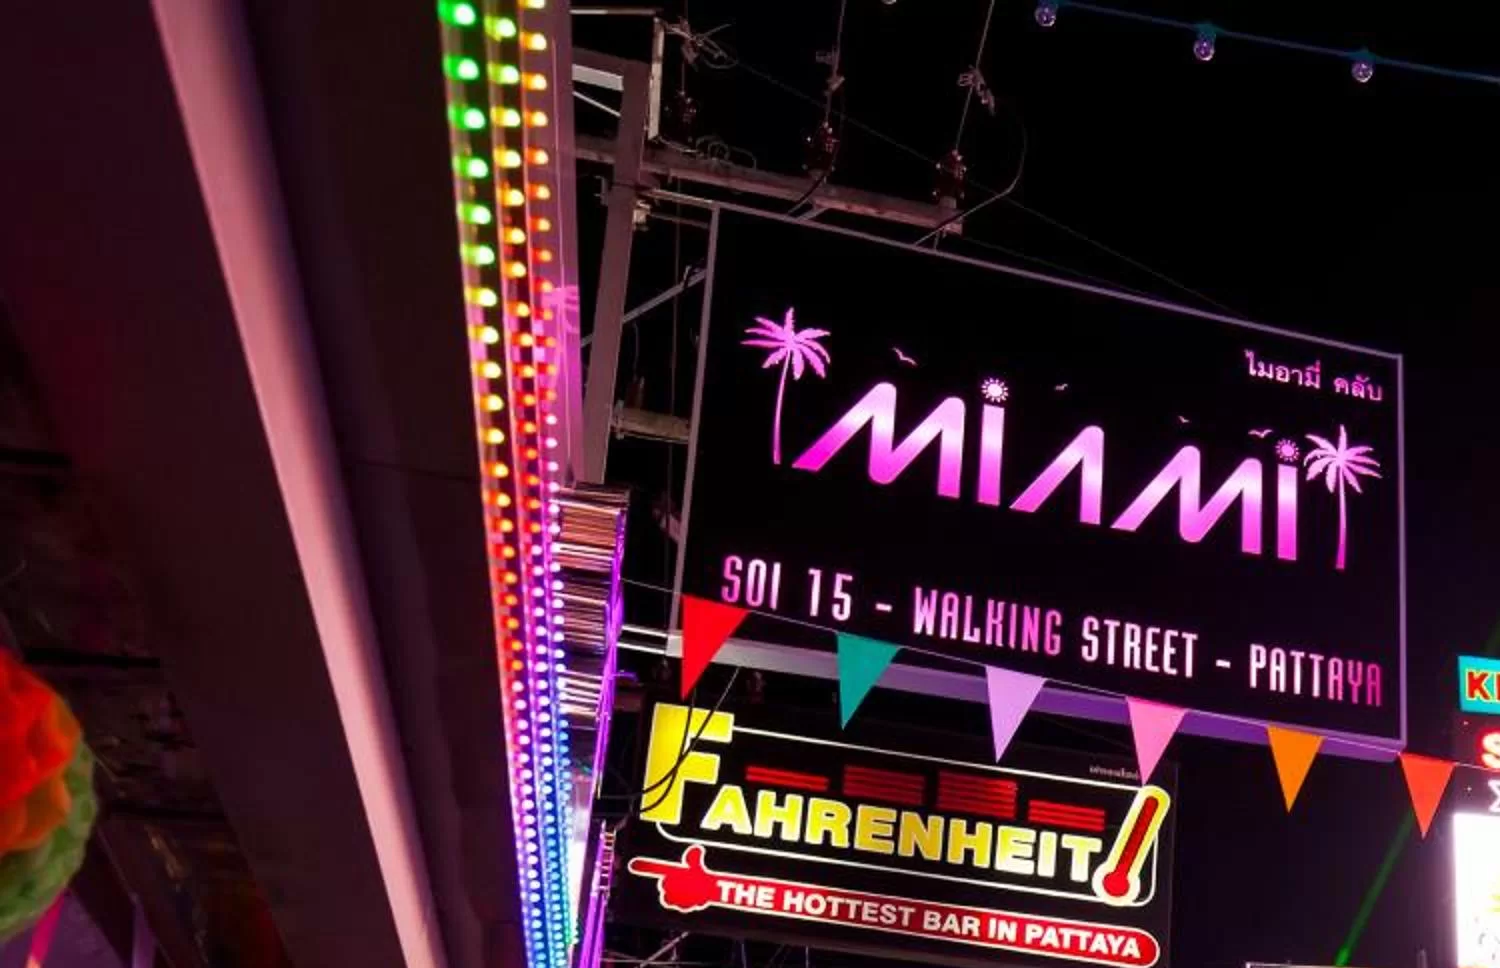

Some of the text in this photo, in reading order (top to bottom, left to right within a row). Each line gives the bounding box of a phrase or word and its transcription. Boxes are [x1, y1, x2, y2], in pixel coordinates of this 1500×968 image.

[1334, 373, 1383, 402] คลับ
[721, 555, 779, 610] SOI
[807, 566, 852, 622] 15
[912, 586, 1062, 656] WALKING
[1081, 615, 1198, 679] STREET
[1249, 645, 1384, 708] PATTAYA
[639, 702, 1103, 884] FAHRENHEIT
[716, 878, 1143, 960] THE HOTTEST BAR IN PATTAYA
